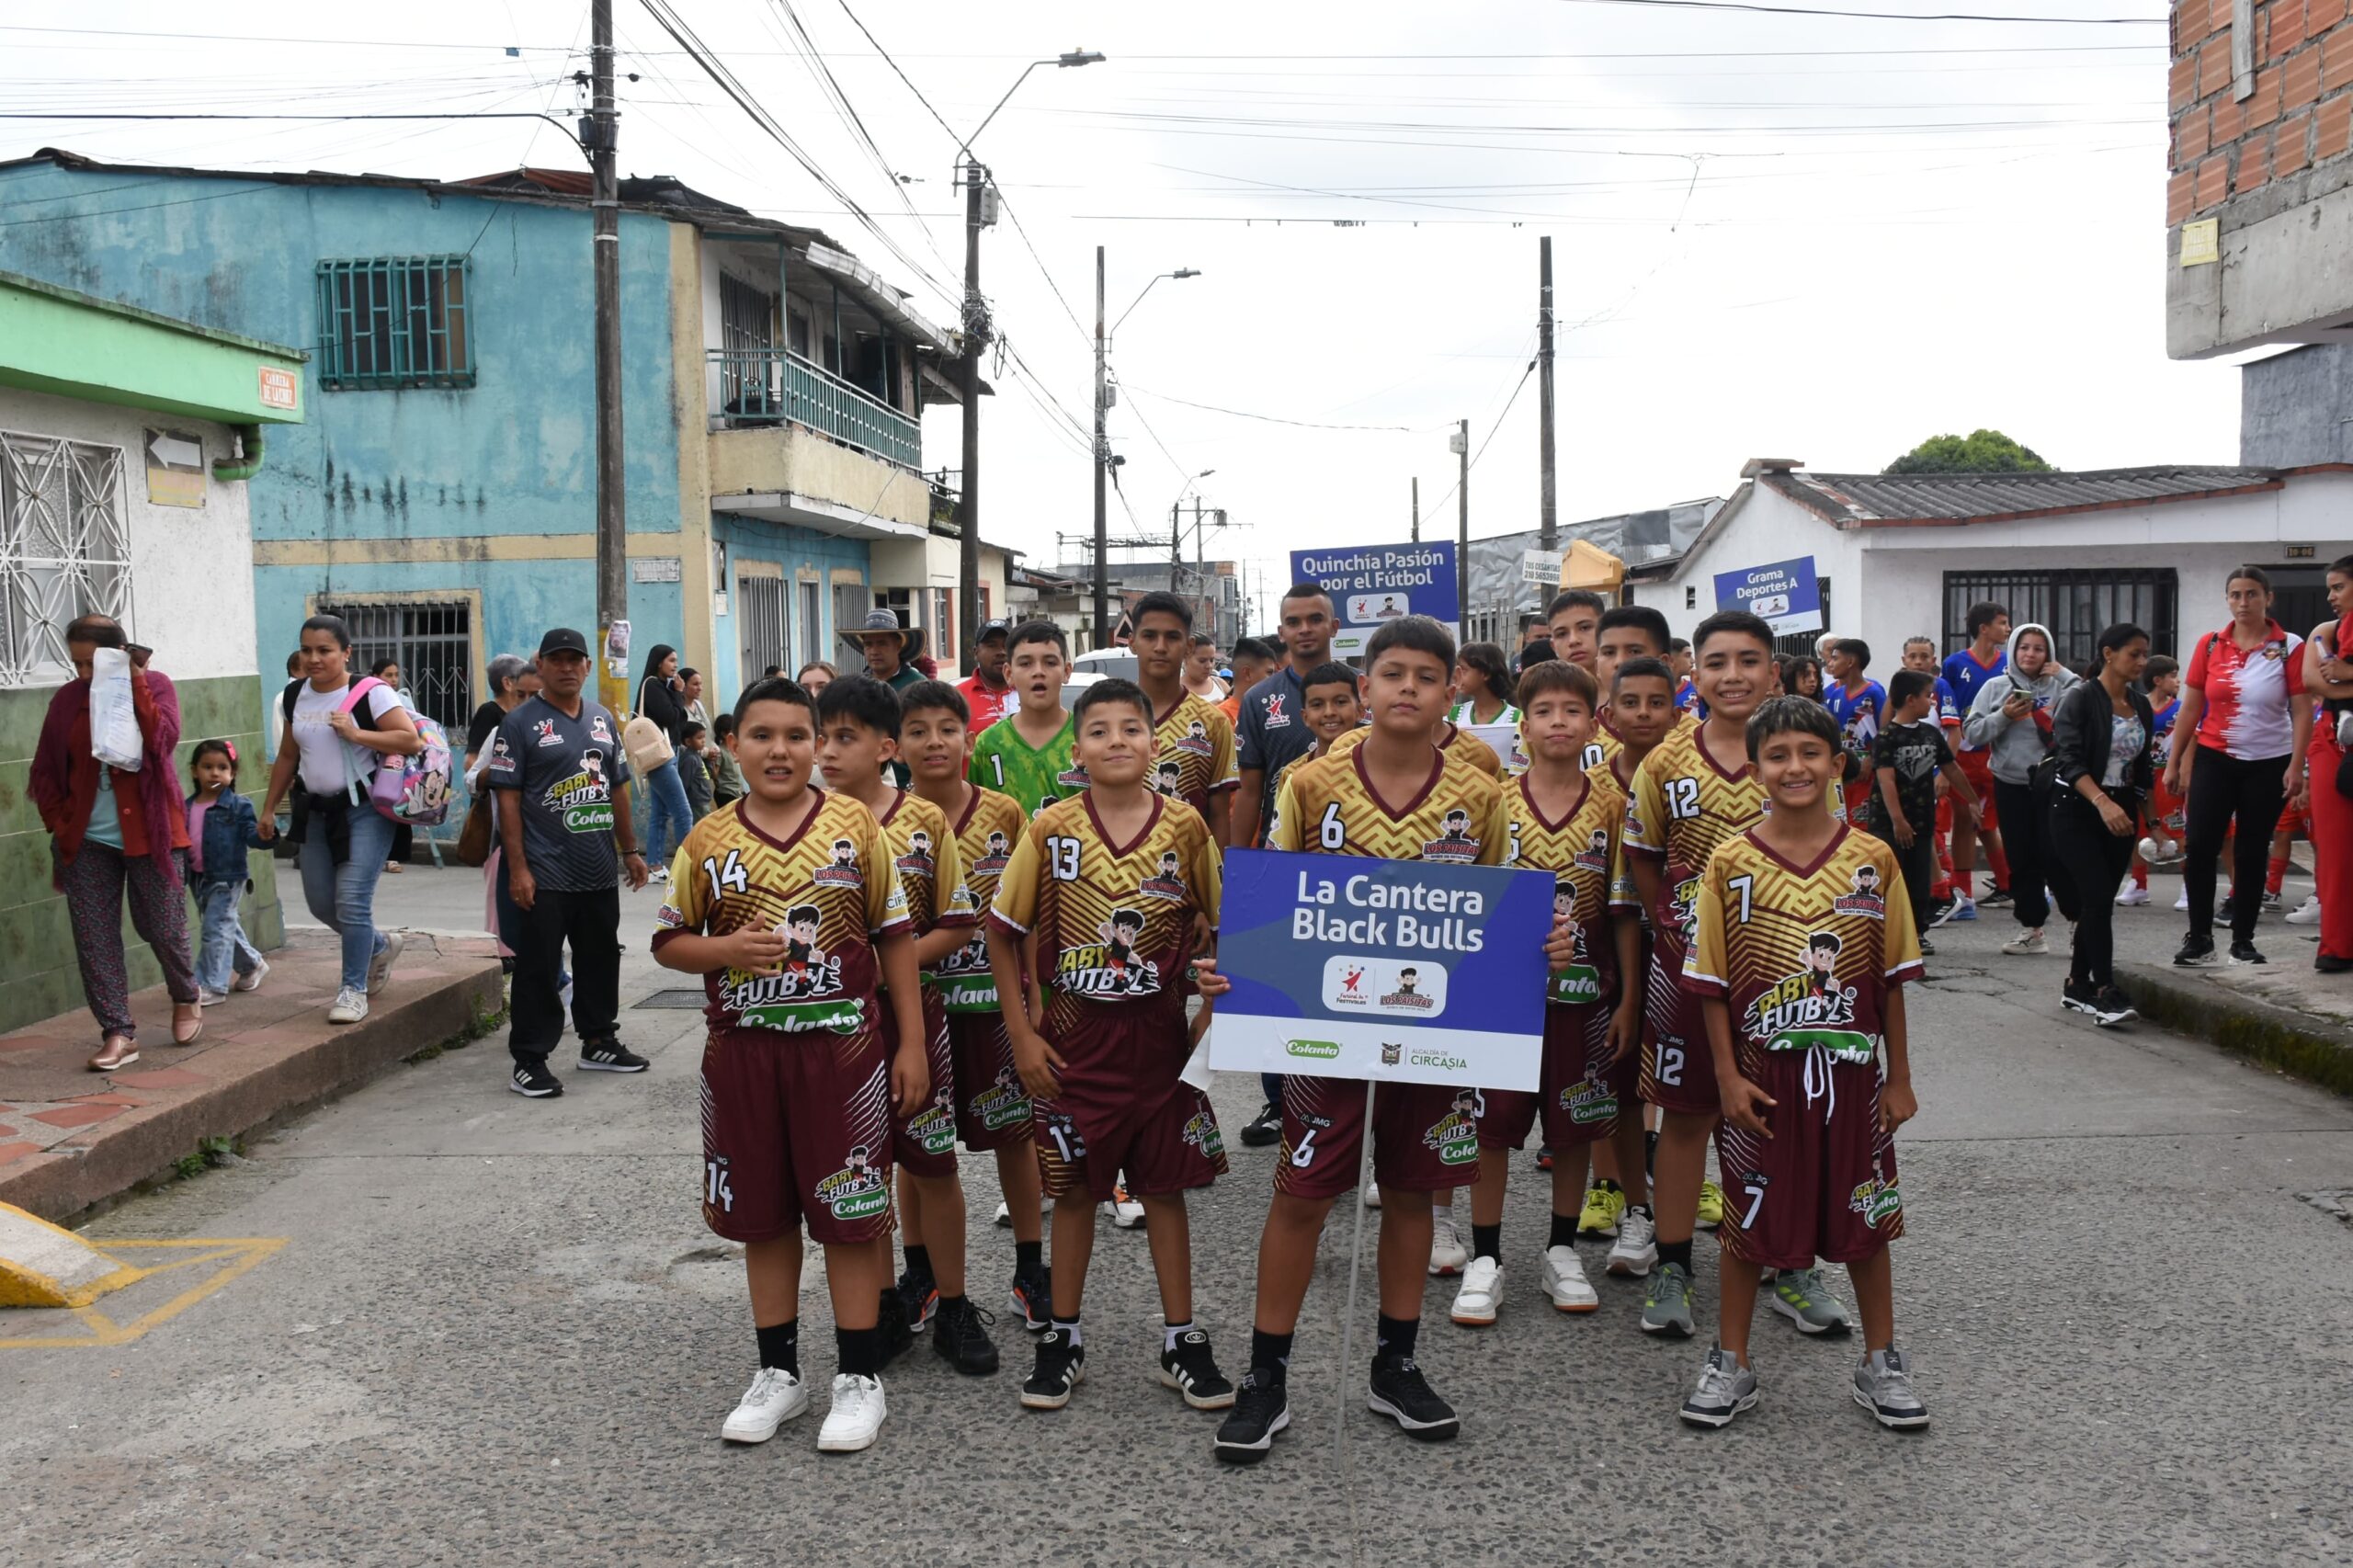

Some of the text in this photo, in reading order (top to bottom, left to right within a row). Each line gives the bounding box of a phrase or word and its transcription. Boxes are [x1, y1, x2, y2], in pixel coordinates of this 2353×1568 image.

[1302, 550, 1444, 576] Quinchía Pasión
[1320, 568, 1433, 592] por el Fútbol
[1747, 570, 1784, 585] Grama
[1736, 577, 1798, 598] Deportes A
[1961, 667, 1971, 682] 4
[991, 754, 1004, 787] 1
[1665, 778, 1699, 819] 12
[1321, 802, 1345, 849] 6
[704, 849, 748, 900] 14
[1047, 836, 1080, 881] 13
[1298, 870, 1483, 915] La Cantera
[1729, 875, 1753, 924] 7
[1292, 908, 1483, 952] Black Bulls
[1062, 946, 1108, 972] ABY
[1381, 995, 1397, 1006] LOS
[1288, 1041, 1338, 1057] Colanta
[1411, 1055, 1467, 1070] CIRCASIA
[1655, 1043, 1684, 1086] 12
[1312, 1118, 1330, 1128] JMG
[1292, 1130, 1316, 1168] 6
[707, 1163, 733, 1212] 14
[1742, 1186, 1764, 1229] 7
